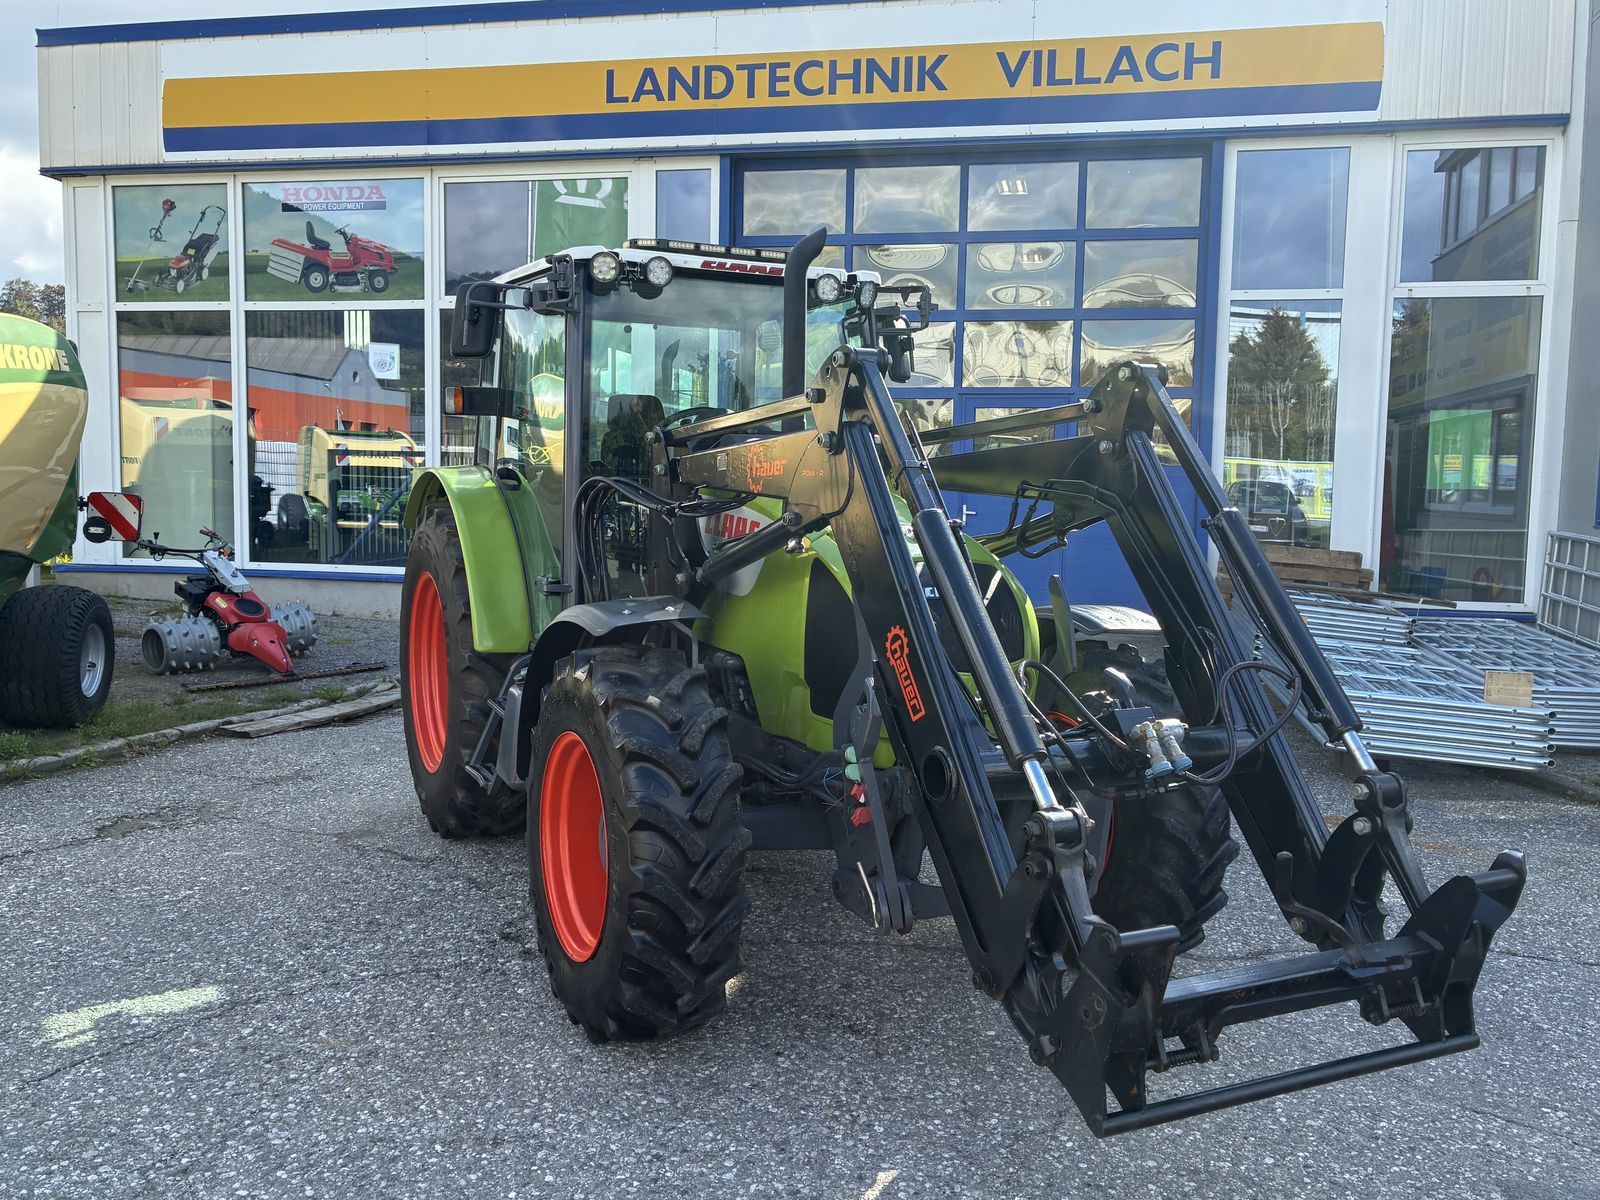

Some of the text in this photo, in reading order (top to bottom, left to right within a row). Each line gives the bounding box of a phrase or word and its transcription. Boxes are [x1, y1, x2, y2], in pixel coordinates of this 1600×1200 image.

[605, 41, 1222, 104] LANDTECHNIK VILLACH
[281, 185, 386, 201] HONDA
[303, 202, 364, 211] POWER EQUIPMENT
[700, 260, 784, 276] CLAAS
[0, 344, 70, 371] KRONE
[752, 456, 787, 478] hauer
[890, 637, 921, 711] hauer
